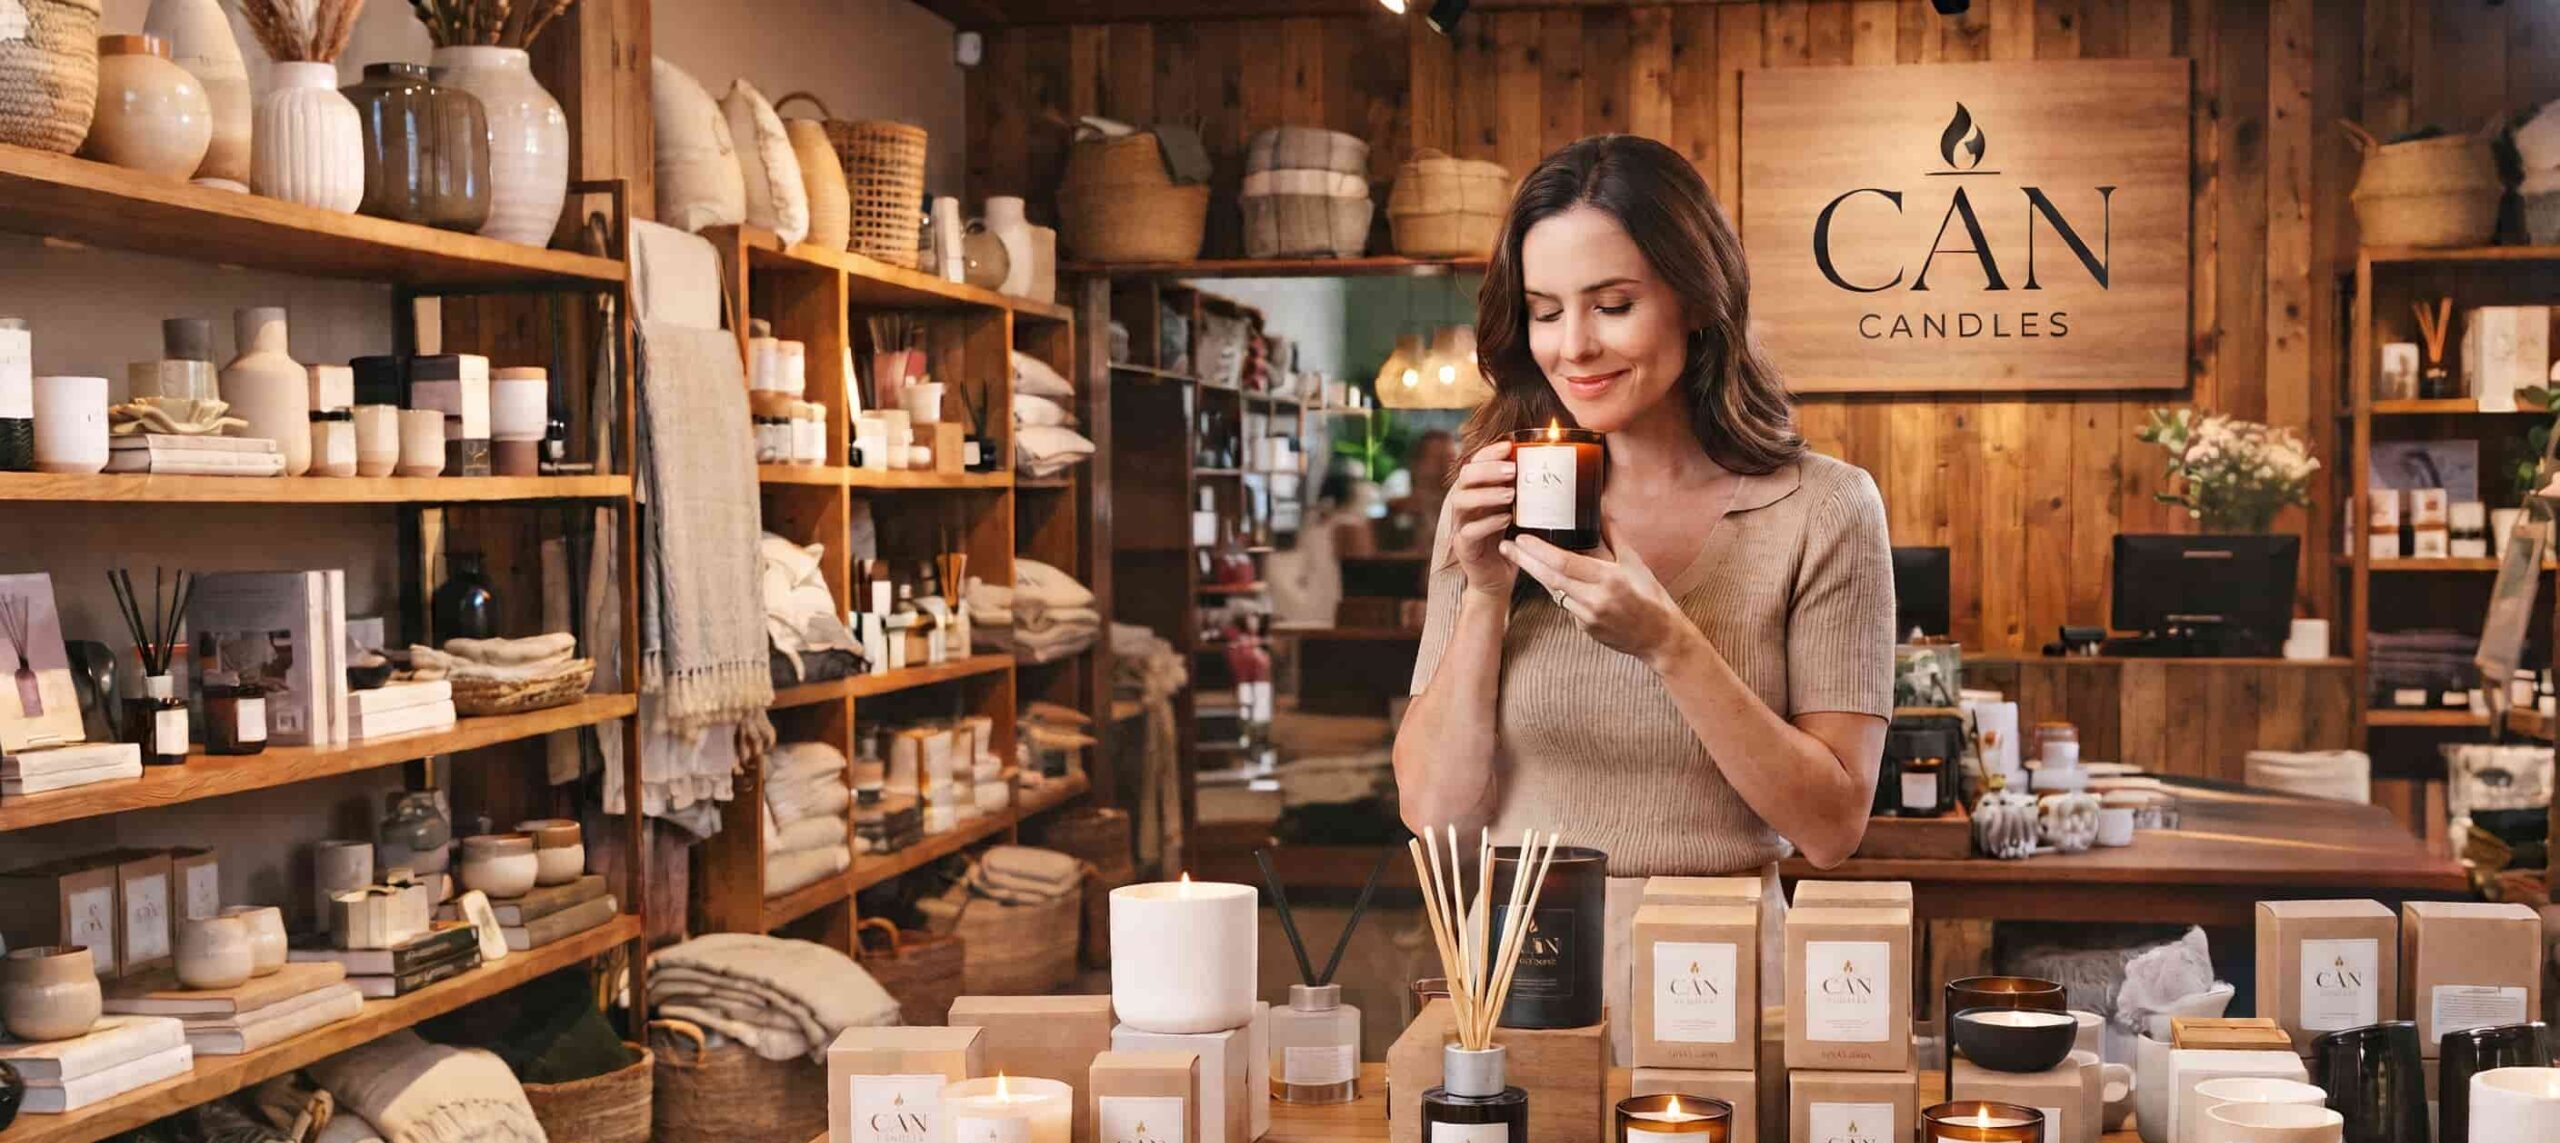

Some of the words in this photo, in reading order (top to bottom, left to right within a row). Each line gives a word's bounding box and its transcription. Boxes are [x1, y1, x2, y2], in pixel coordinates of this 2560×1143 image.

[1813, 185, 2117, 293] CAN
[1858, 312, 2069, 339] CANDLES
[1669, 978, 1719, 996] CAN
[1822, 977, 1872, 995] CAN
[2315, 971, 2362, 989] CAN
[870, 1112, 928, 1133] CAN
